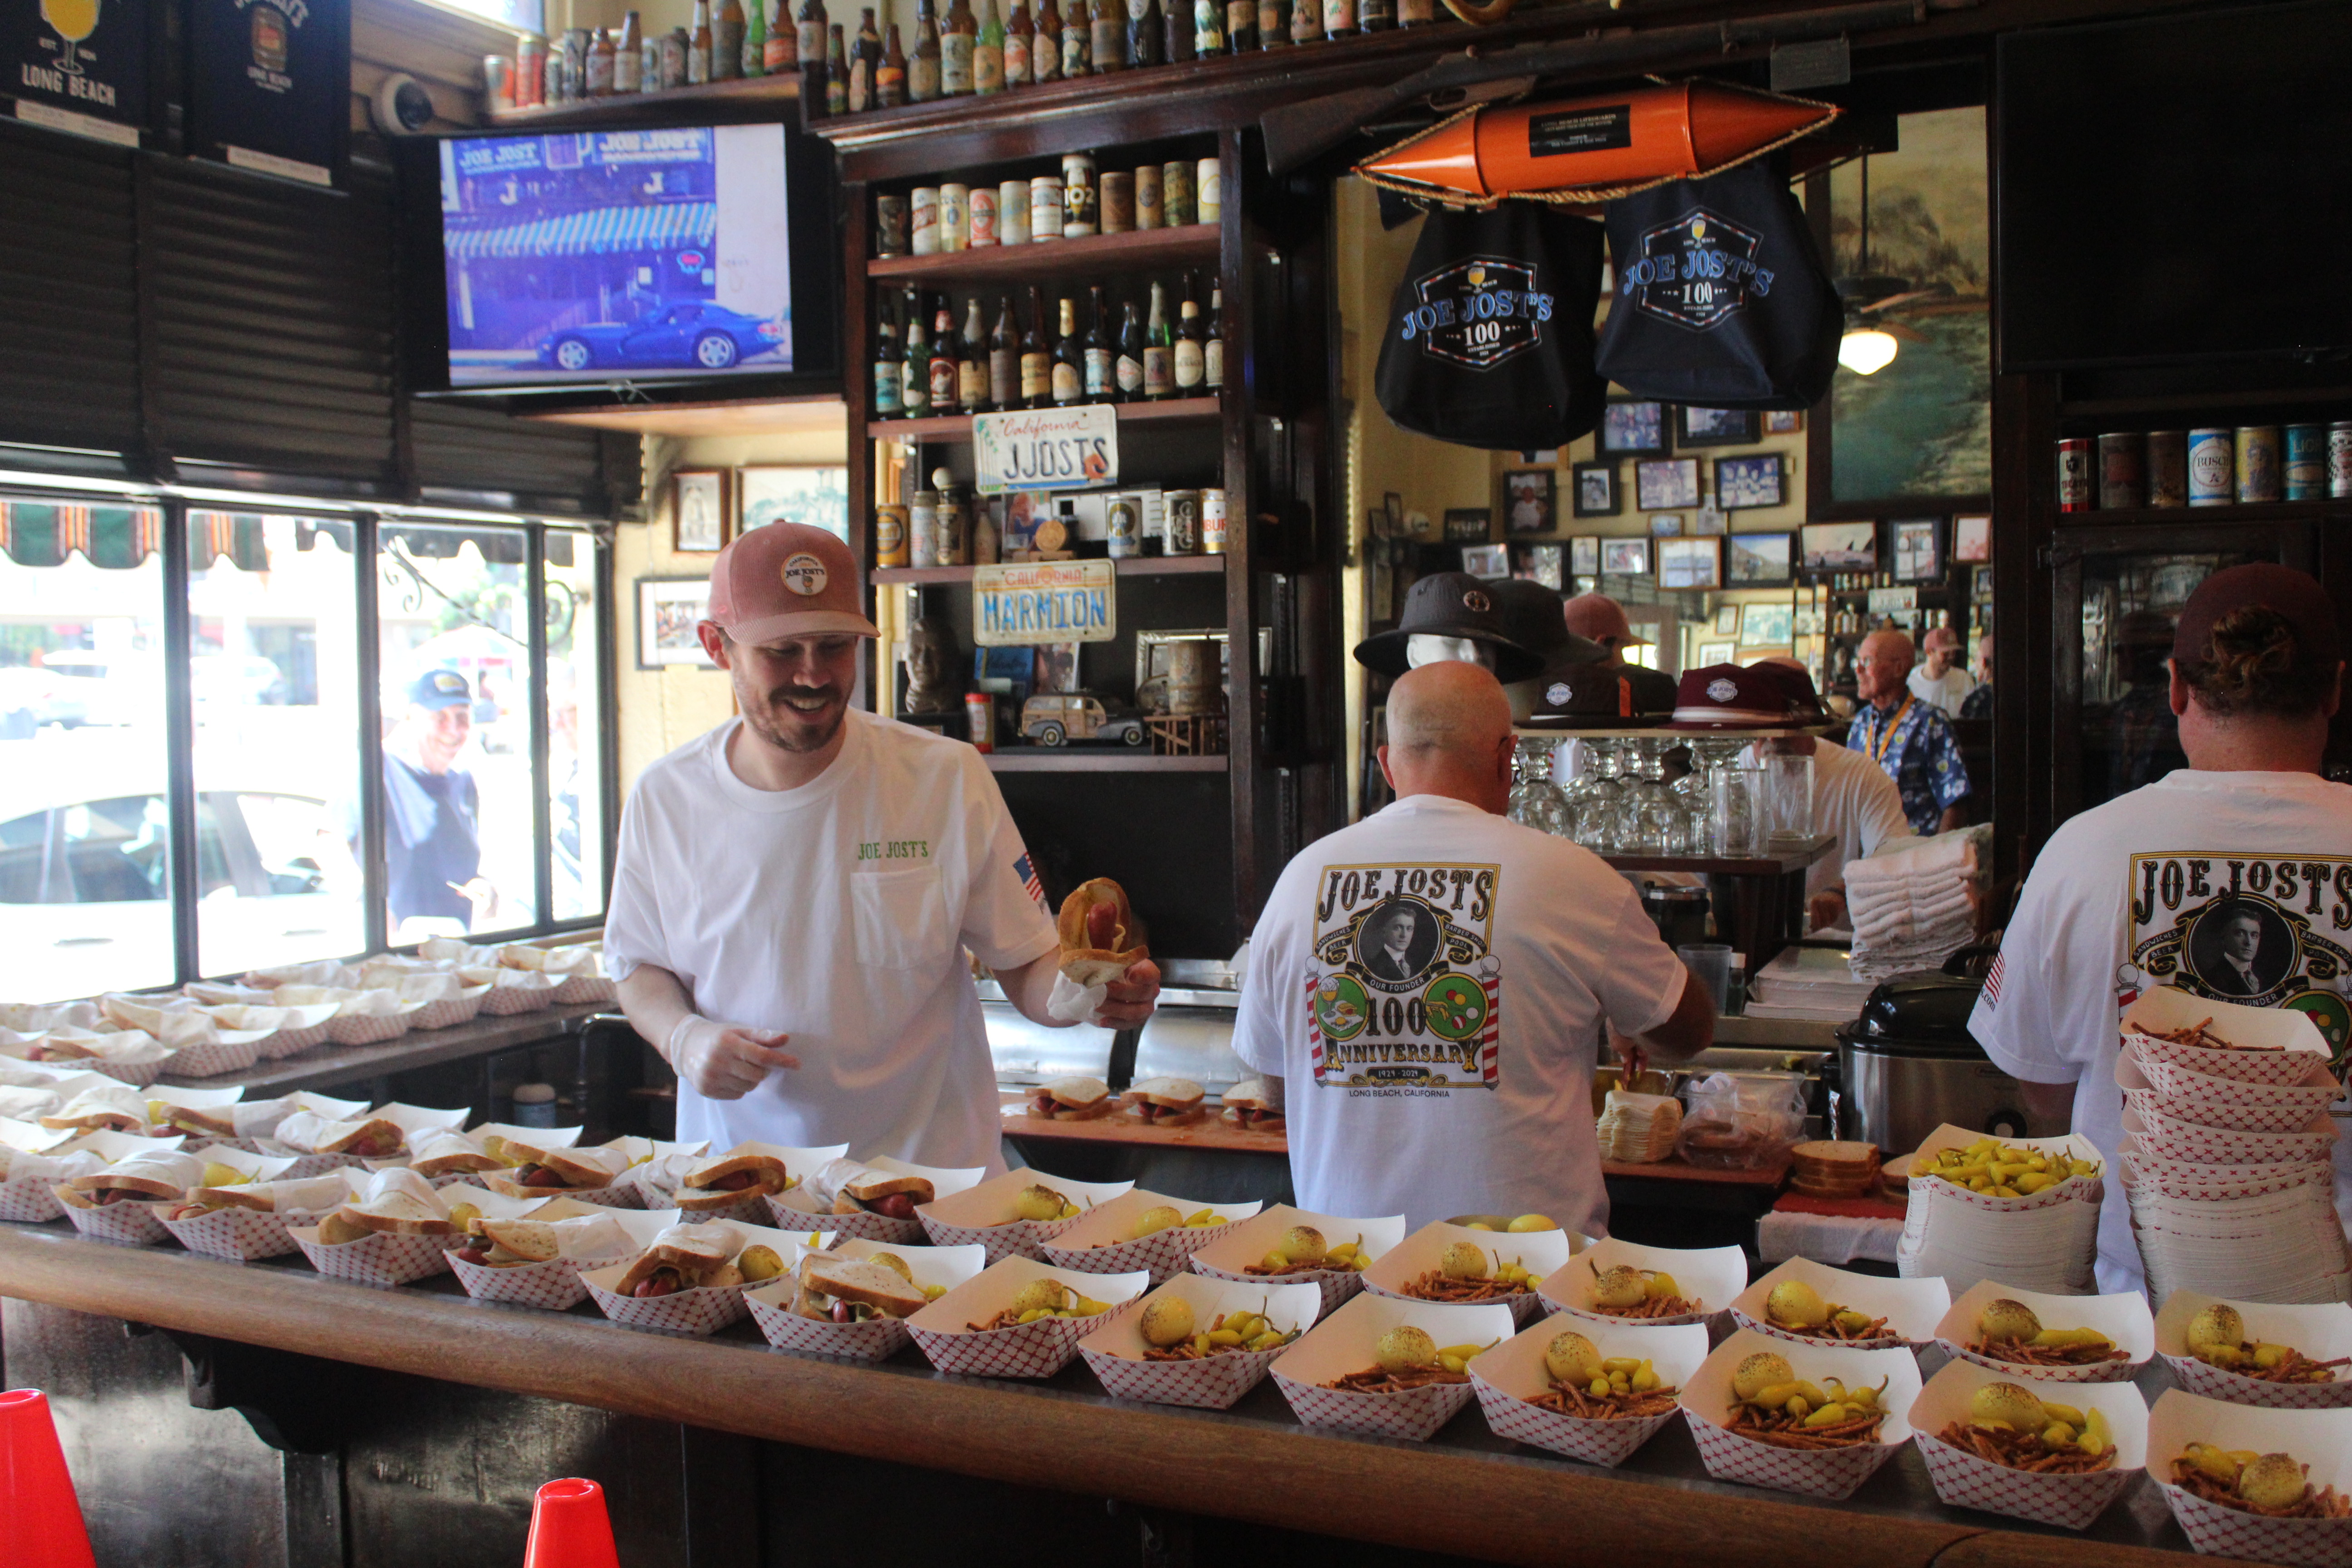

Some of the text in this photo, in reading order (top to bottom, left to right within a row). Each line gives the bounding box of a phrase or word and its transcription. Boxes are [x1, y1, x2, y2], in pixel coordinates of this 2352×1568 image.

[21, 64, 116, 107] LONG BEACH
[643, 131, 701, 151] JOST
[459, 148, 493, 168] JOE
[495, 142, 537, 163] JOST
[1623, 249, 1775, 297] JOE JOST'S
[1681, 281, 1712, 304] 100
[1401, 290, 1554, 340] JOE JOST'S
[1463, 321, 1500, 347] 100
[1003, 417, 1088, 436] California
[1004, 437, 1109, 480] JJOSTS
[2198, 456, 2230, 467] BUSCH
[786, 569, 800, 578] JOE
[1005, 569, 1083, 586] CALIFORNIA
[983, 590, 1106, 632] MARMION
[858, 841, 928, 860] JOE JOST'S
[1318, 868, 1493, 922] JOE JOSTS
[2134, 860, 2352, 931] JOE JOSTS
[1316, 926, 1351, 949] SANDWICHES
[1445, 924, 1471, 939] BARBER
[2301, 931, 2333, 948] BARBER
[1329, 940, 1346, 951] BEER
[1450, 939, 1468, 949] POOL
[2133, 930, 2178, 957] SANDWICHES
[2151, 945, 2174, 958] BEER
[2308, 949, 2331, 960] POOL
[1370, 977, 1425, 991] OUR FOUNDER
[1365, 996, 1427, 1037] 100
[1323, 1038, 1485, 1073] ANNIVERSARY
[1404, 1089, 1450, 1098] CALIFORNIA
